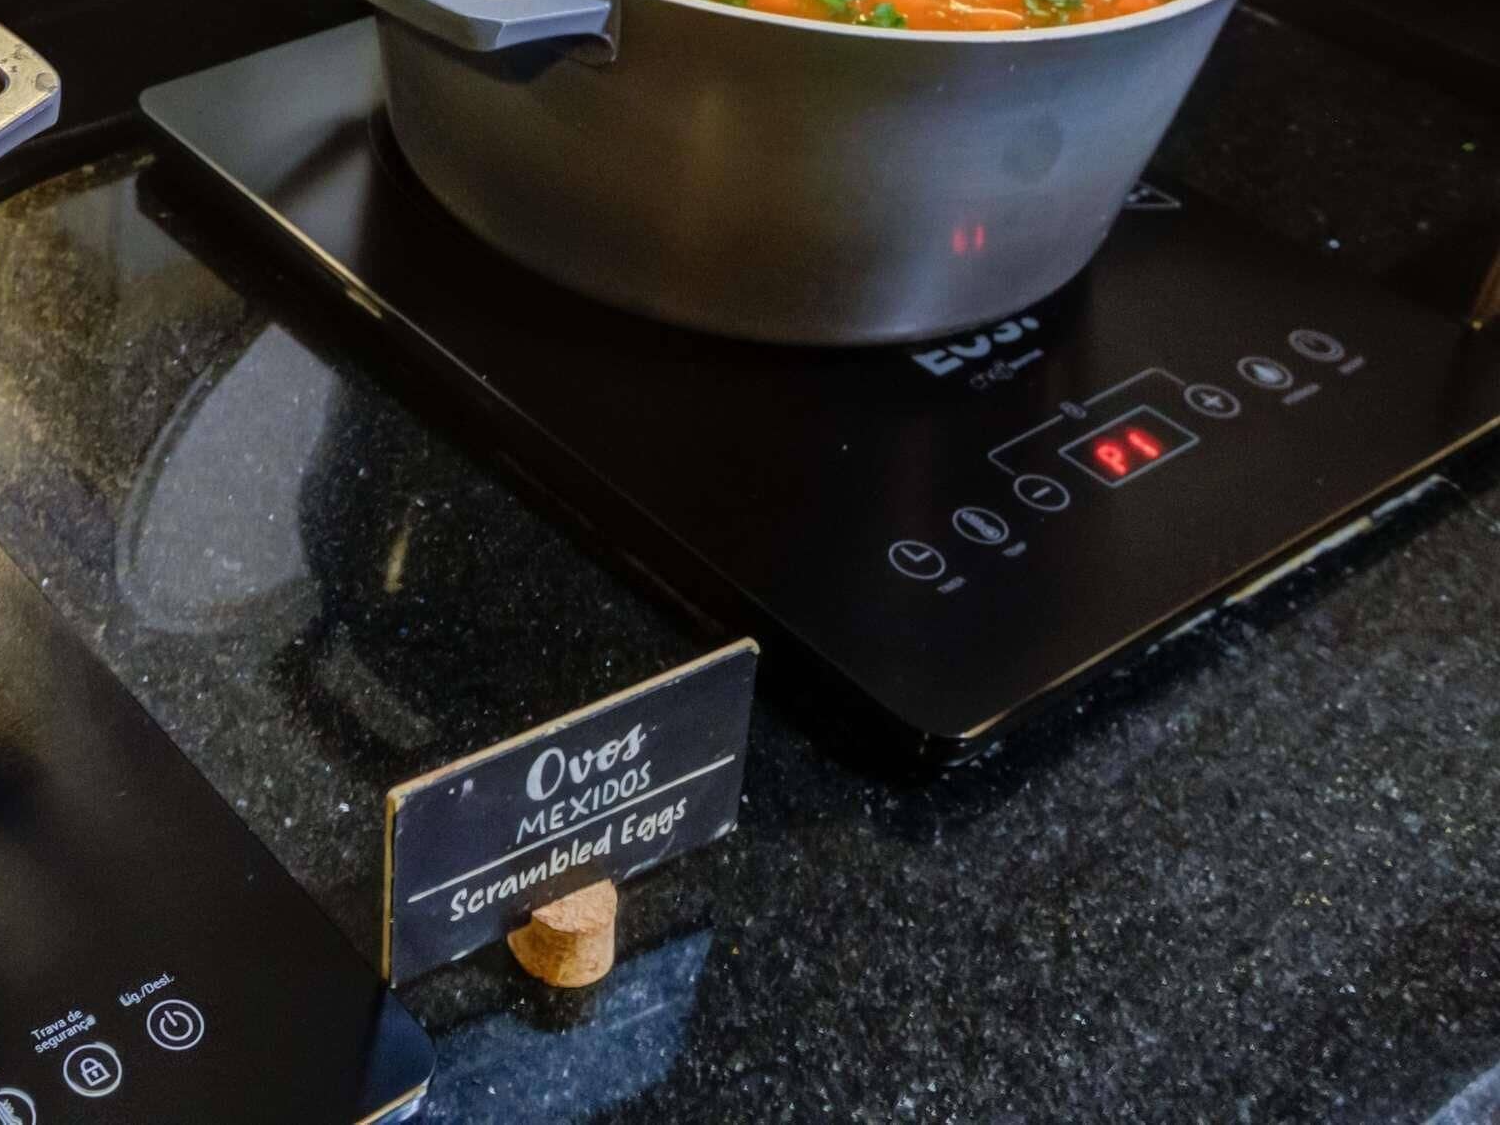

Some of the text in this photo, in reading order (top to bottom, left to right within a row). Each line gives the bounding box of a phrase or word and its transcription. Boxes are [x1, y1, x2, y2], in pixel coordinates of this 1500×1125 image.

[1093, 428, 1161, 476] P1
[526, 723, 648, 801] Ovos
[515, 760, 652, 844] MEXIDOS
[450, 796, 688, 922] Scrambled Eggs
[30, 1009, 84, 1042] Trava de
[34, 1013, 97, 1054] segurança
